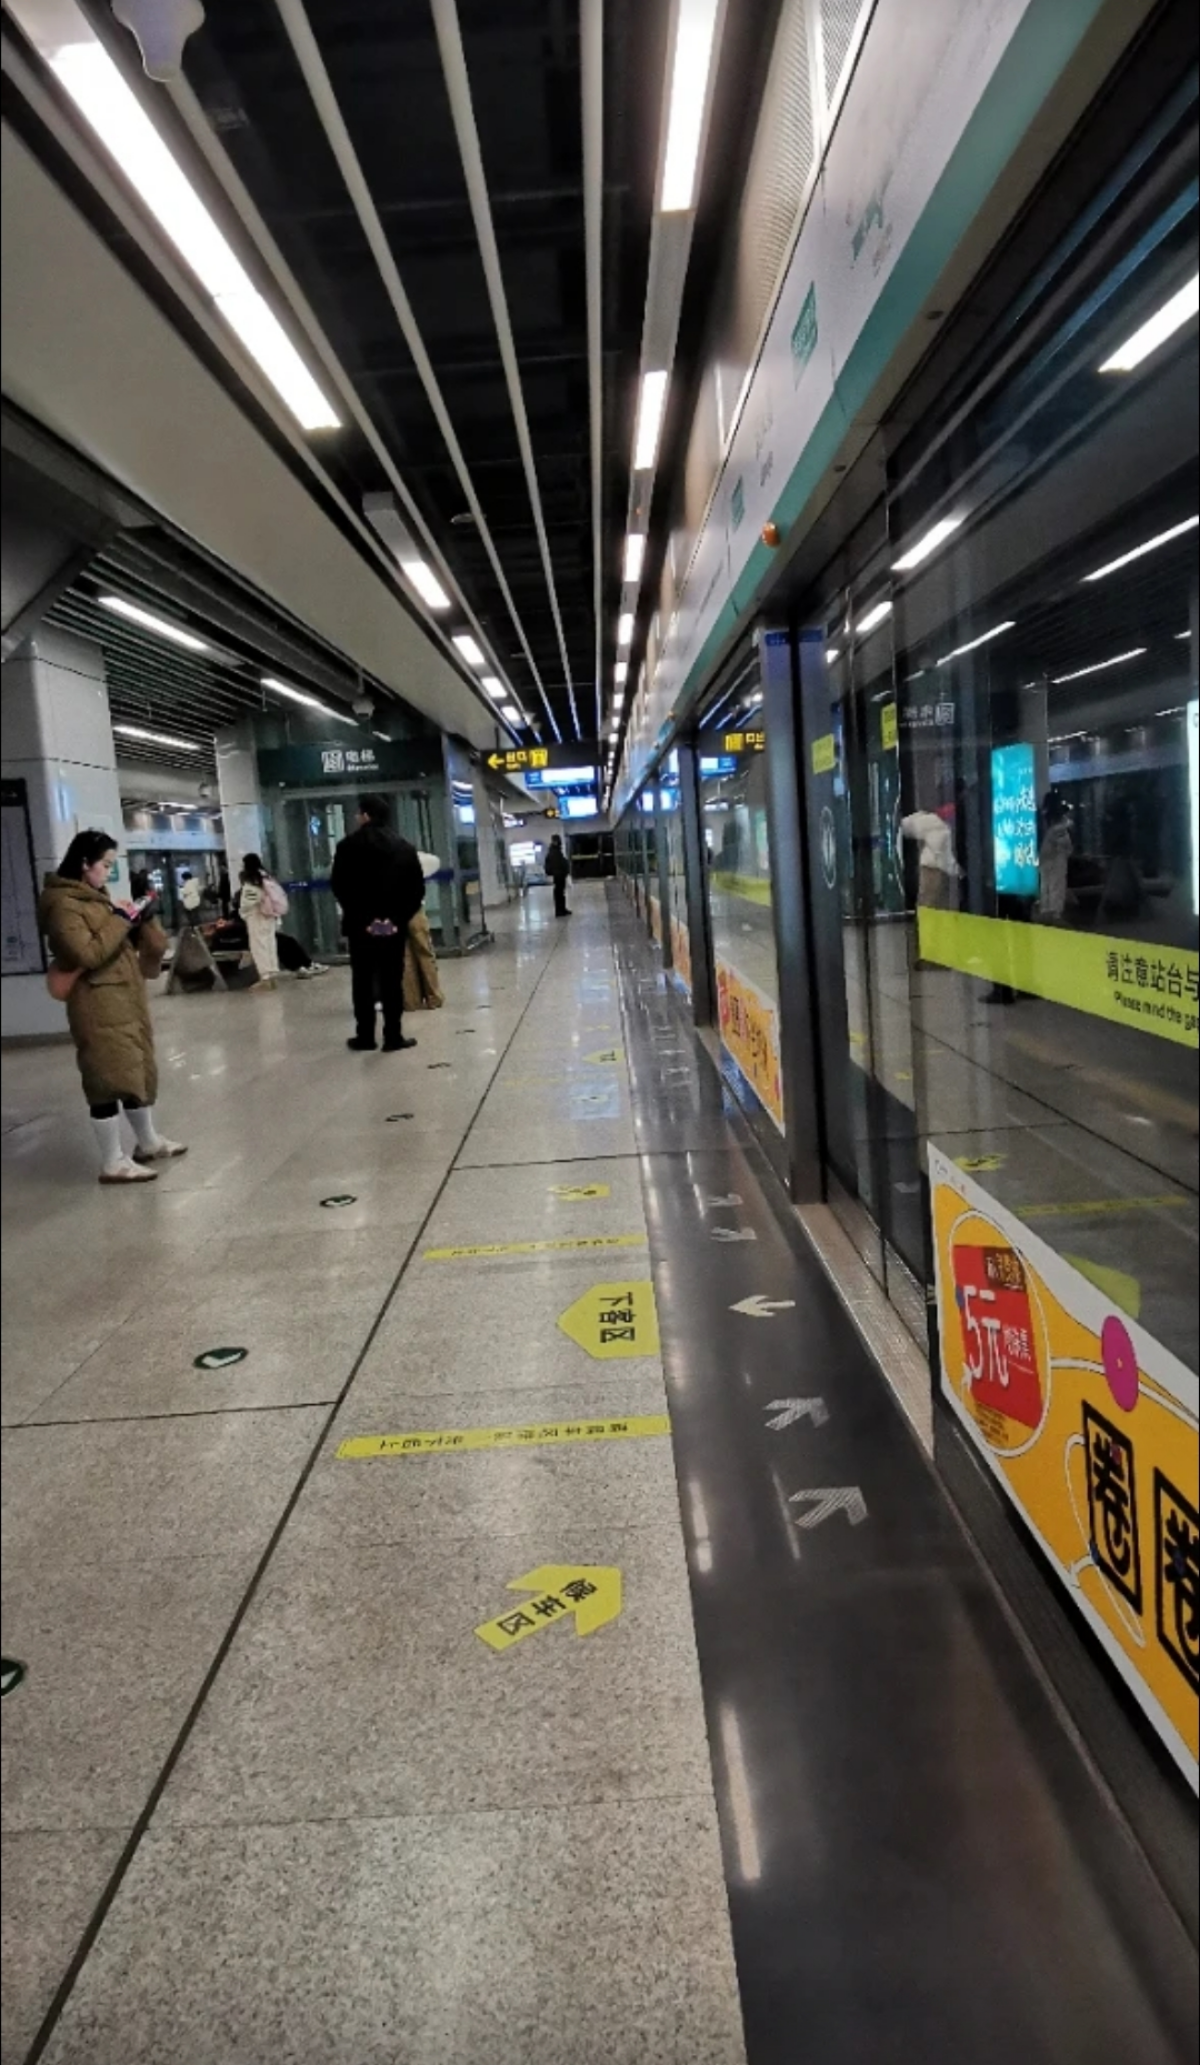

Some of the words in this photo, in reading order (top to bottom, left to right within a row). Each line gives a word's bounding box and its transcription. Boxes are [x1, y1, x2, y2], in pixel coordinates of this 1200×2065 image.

[1113, 989, 1141, 1013] Please
[1142, 1000, 1166, 1019] mind
[1166, 1006, 1182, 1024] the
[598, 1291, 637, 1344] 下客区
[495, 1576, 601, 1638] 候车区
